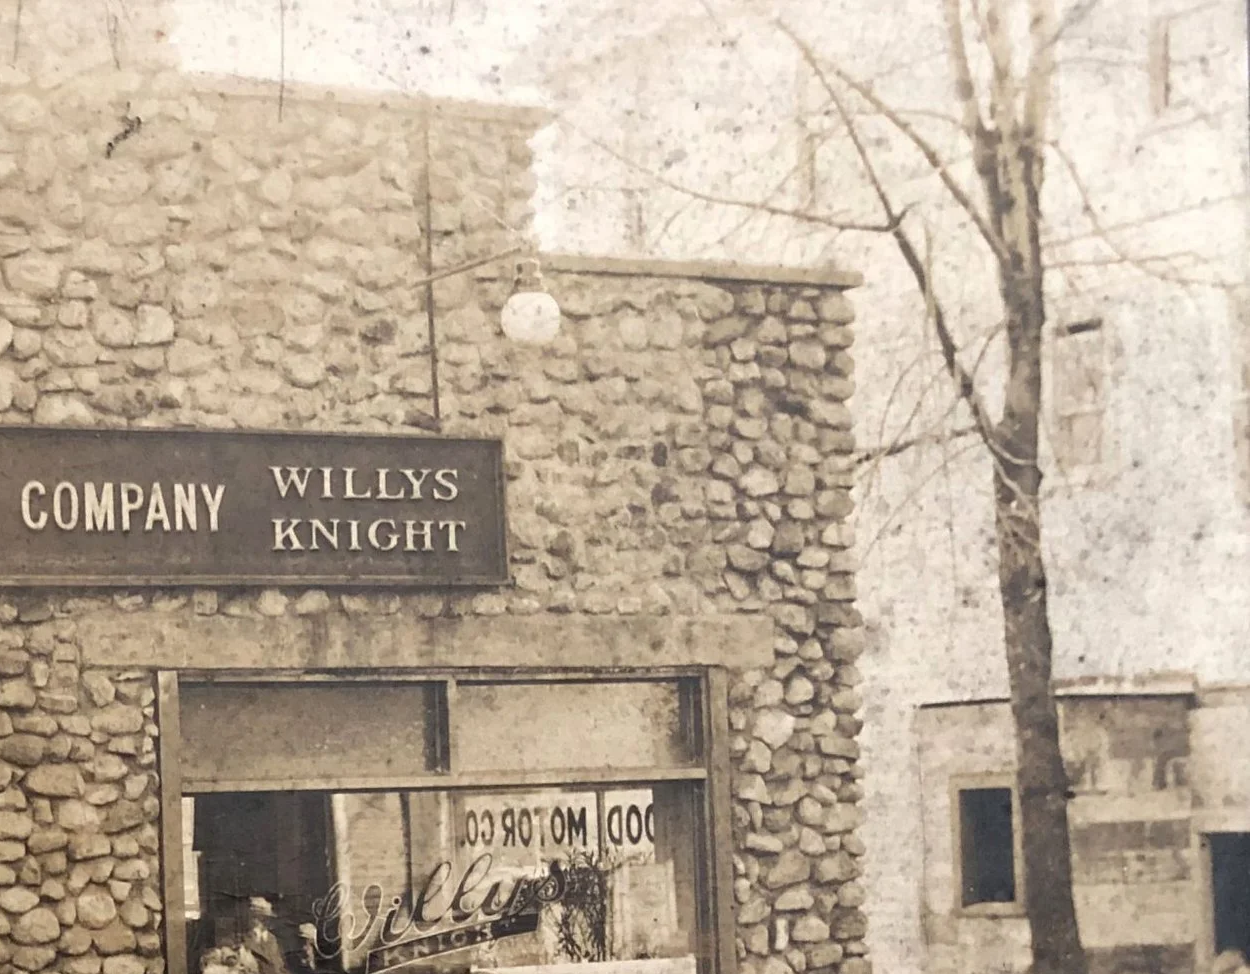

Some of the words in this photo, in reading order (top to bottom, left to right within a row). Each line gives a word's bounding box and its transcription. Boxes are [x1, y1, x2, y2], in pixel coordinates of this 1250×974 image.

[268, 466, 459, 501] WILLYS
[20, 480, 227, 532] COMPANY
[270, 517, 467, 552] KNIGHT
[312, 852, 566, 960] Willys
